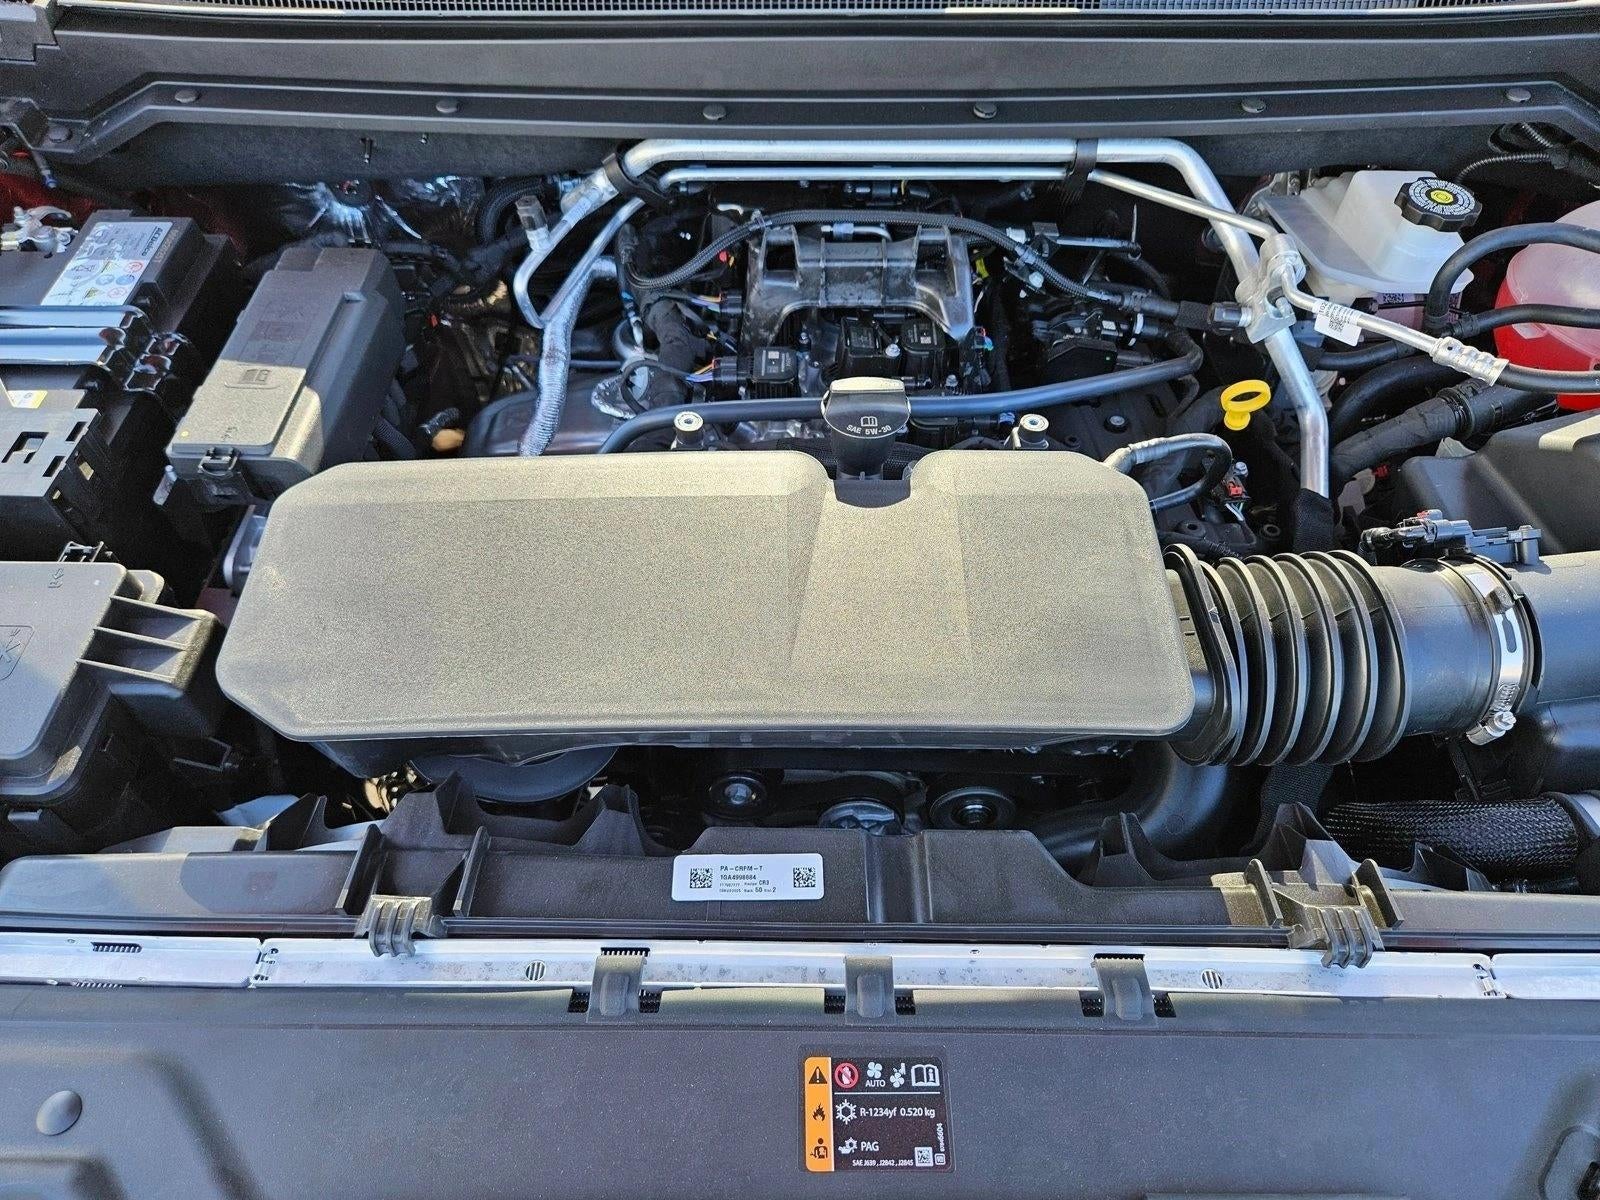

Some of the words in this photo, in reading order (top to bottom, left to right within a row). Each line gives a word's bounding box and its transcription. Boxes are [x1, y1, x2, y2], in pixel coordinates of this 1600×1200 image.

[846, 424, 862, 434] SAE
[865, 424, 892, 435] 5W-30
[865, 1079, 886, 1087] AUTO
[860, 1108, 897, 1119] R-1234yf
[900, 1108, 924, 1117] 0.520
[924, 1108, 935, 1118] kg
[861, 1141, 879, 1151] PAG
